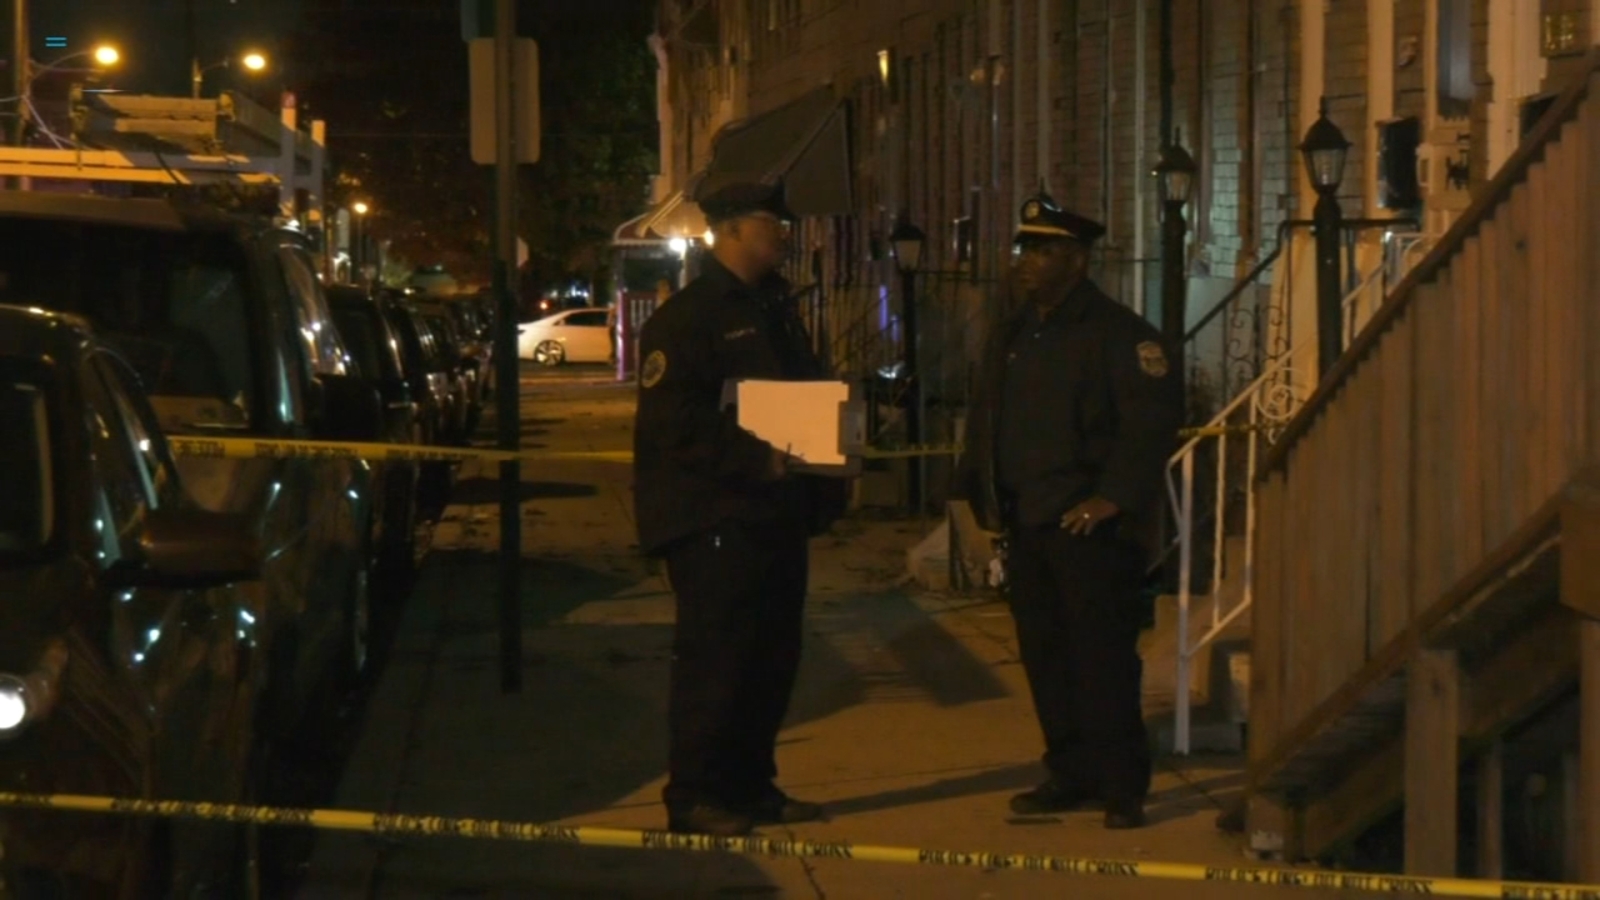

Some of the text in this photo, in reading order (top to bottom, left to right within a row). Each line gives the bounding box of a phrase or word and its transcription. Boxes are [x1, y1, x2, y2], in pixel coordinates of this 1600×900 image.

[642, 831, 691, 849] POLICE
[801, 842, 850, 858] CROSS
[918, 849, 970, 866] POLICE
[1083, 860, 1137, 876] CROSS
[1205, 868, 1260, 883] POLICE
[1376, 878, 1431, 893] CROSS
